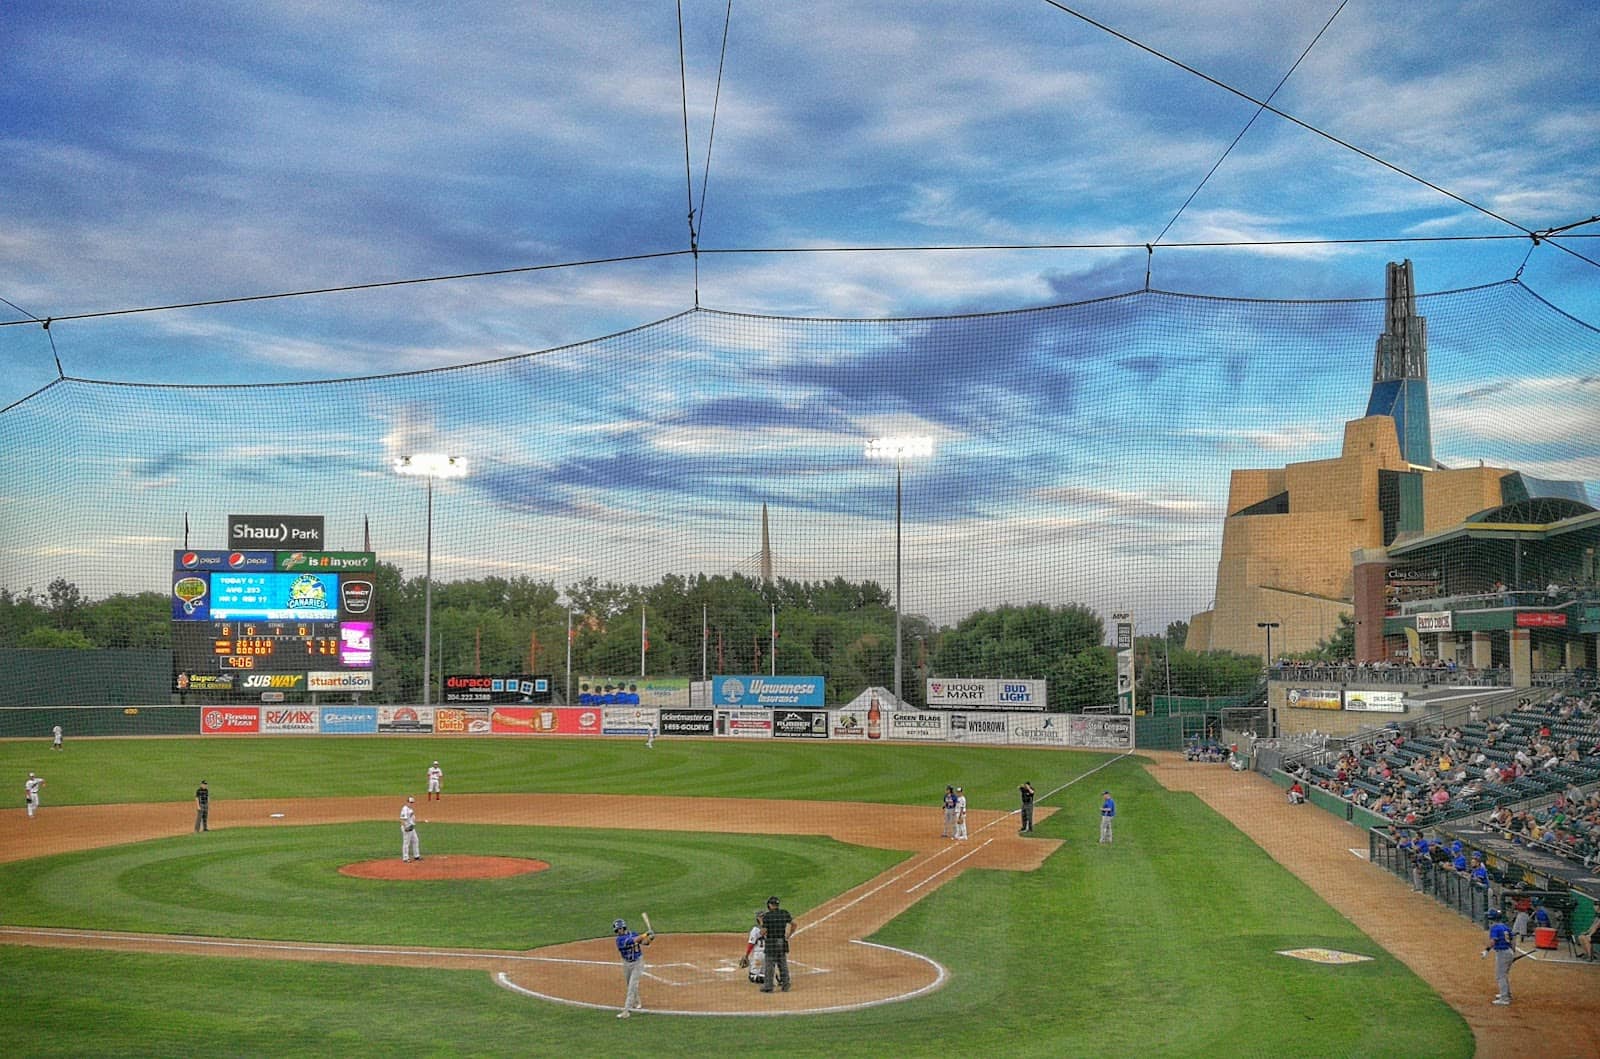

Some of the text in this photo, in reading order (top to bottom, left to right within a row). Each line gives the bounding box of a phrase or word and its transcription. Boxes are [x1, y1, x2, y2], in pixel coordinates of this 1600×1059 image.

[291, 528, 318, 539] Park
[199, 557, 221, 565] pepsi
[308, 557, 368, 568] is it in you?
[288, 598, 327, 609] CANARIES
[228, 657, 253, 668] 9:06
[243, 675, 303, 688] SUBWAY
[310, 676, 370, 686] stuartolson
[447, 676, 492, 688] duraco
[749, 680, 815, 694] Wawanesa
[1004, 684, 1026, 693] BUD
[758, 694, 799, 703] Insurance
[947, 691, 984, 699] MART
[999, 693, 1031, 701] LIGHT
[265, 710, 314, 724] RE/MAX
[661, 713, 712, 721] ticketmaster.ca
[968, 720, 1006, 733] WYBOROWA
